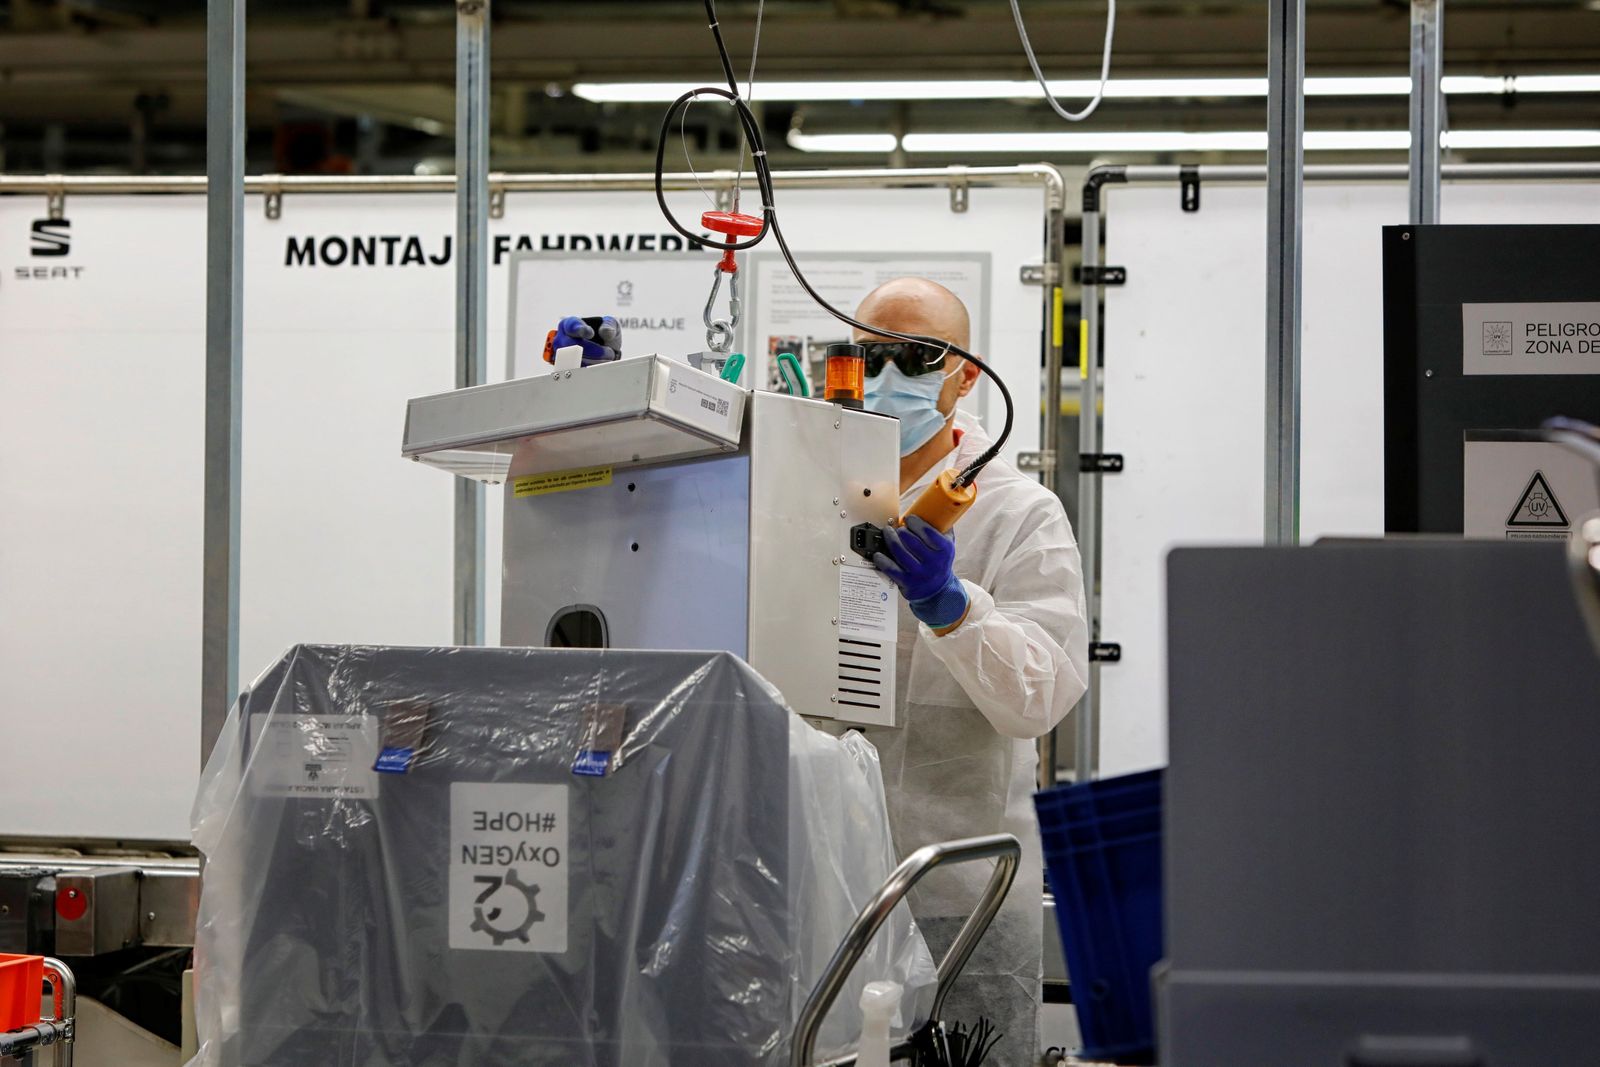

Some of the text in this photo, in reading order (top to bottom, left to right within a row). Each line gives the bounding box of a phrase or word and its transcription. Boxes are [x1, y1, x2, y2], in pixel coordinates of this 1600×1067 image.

[284, 235, 453, 266] MONTAJ
[14, 265, 85, 280] SEAT
[620, 316, 685, 331] MBALAJE
[1525, 322, 1600, 336] PELIGRO
[1525, 339, 1600, 354] ZONA DE
[1531, 502, 1546, 512] UV
[472, 811, 556, 833] #HOPE
